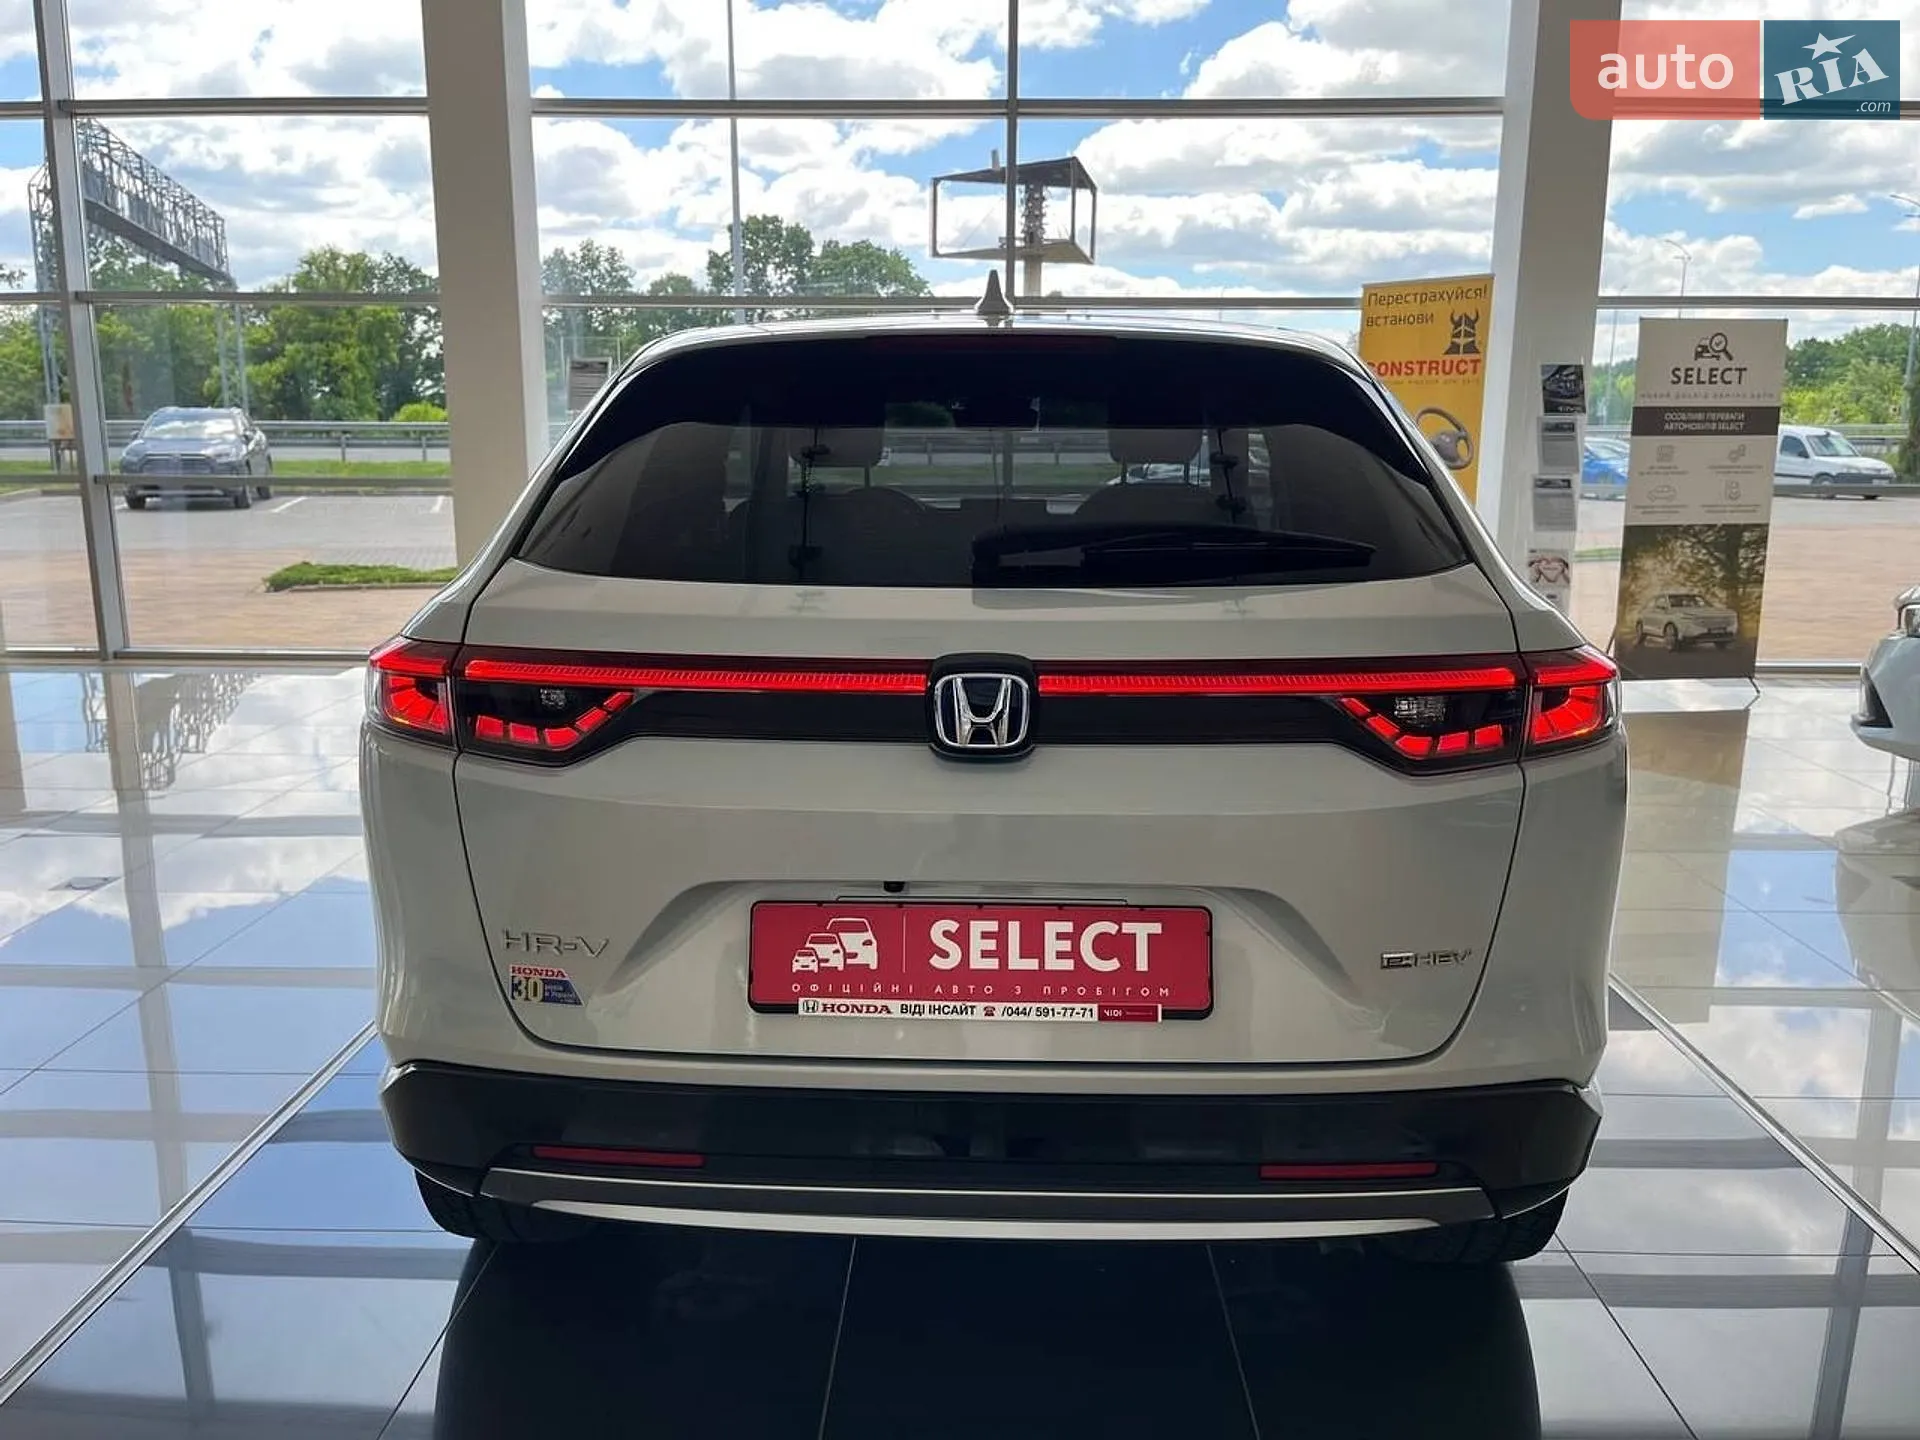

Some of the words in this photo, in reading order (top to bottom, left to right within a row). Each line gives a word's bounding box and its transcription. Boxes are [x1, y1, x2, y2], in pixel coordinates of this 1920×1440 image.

[1368, 284, 1488, 306] Перестрахуйся!
[1366, 313, 1434, 327] встанови
[1670, 367, 1748, 385] SELECT
[503, 930, 609, 958] HR-V
[929, 920, 1162, 971] SELECT
[511, 966, 566, 977] HONDA
[513, 977, 543, 1001] 30
[792, 983, 913, 993] ОФІЦІЙНІ
[935, 985, 993, 994] АВТО
[1044, 986, 1169, 997] ПРОБІГОМ
[822, 1004, 892, 1014] HONDA
[900, 1004, 925, 1016] ВІДІ
[929, 1004, 976, 1015] ІНСАЙТ
[1001, 1006, 1032, 1016] /044/
[1035, 1008, 1094, 1018] 591-77-71
